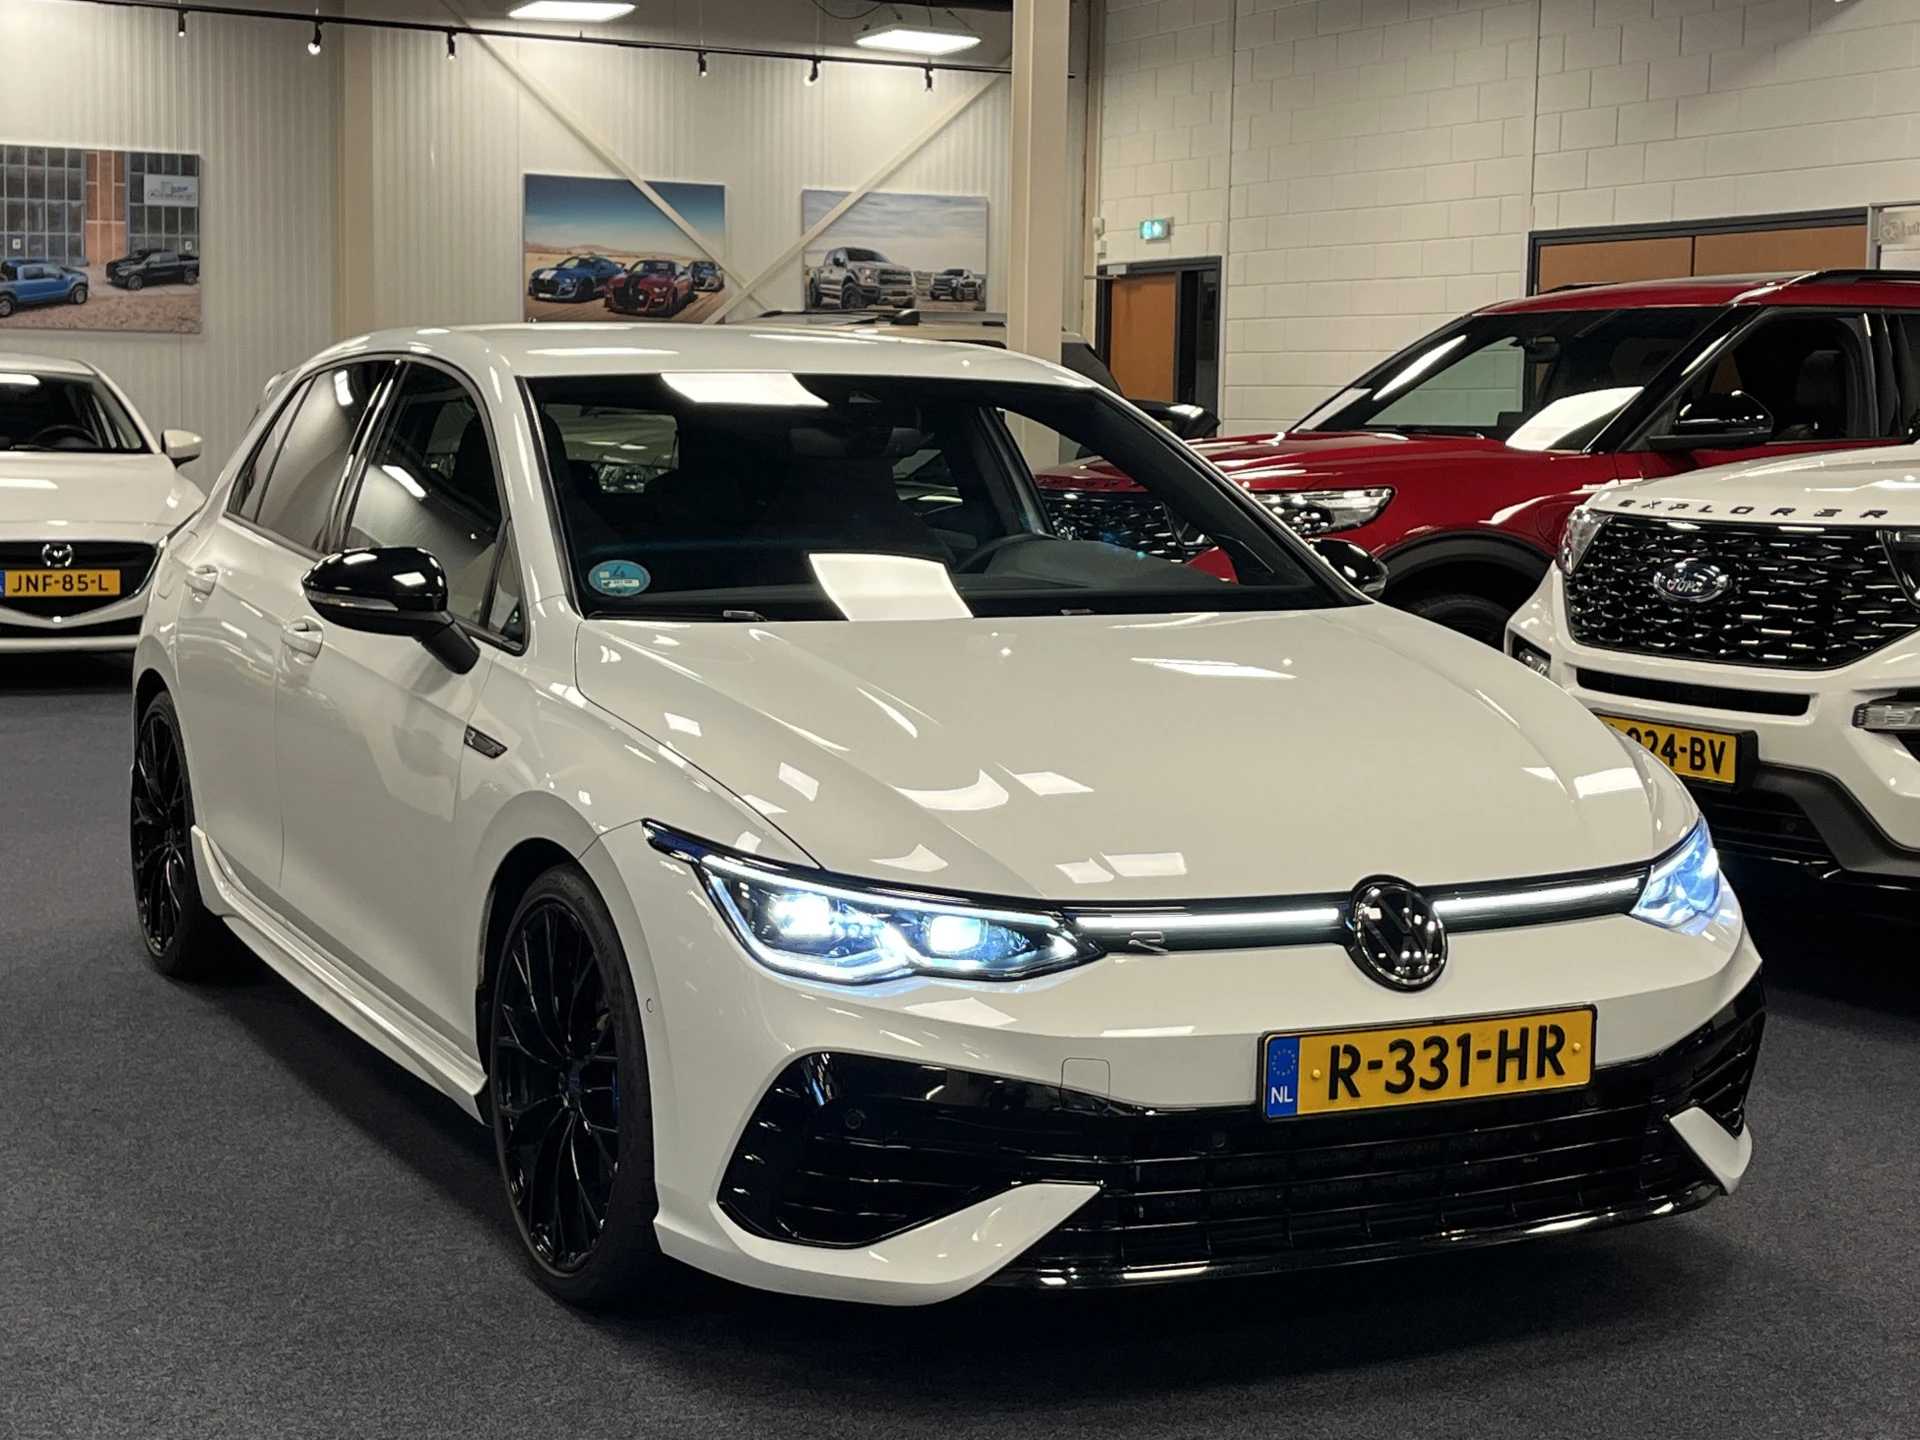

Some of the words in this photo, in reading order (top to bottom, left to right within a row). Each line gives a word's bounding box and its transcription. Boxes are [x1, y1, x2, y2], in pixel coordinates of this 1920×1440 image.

[1618, 498, 1888, 519] EXPLORER
[12, 574, 109, 593] JNF-85-L
[1328, 1023, 1566, 1101] R-331-HR
[1271, 1085, 1294, 1104] NL
